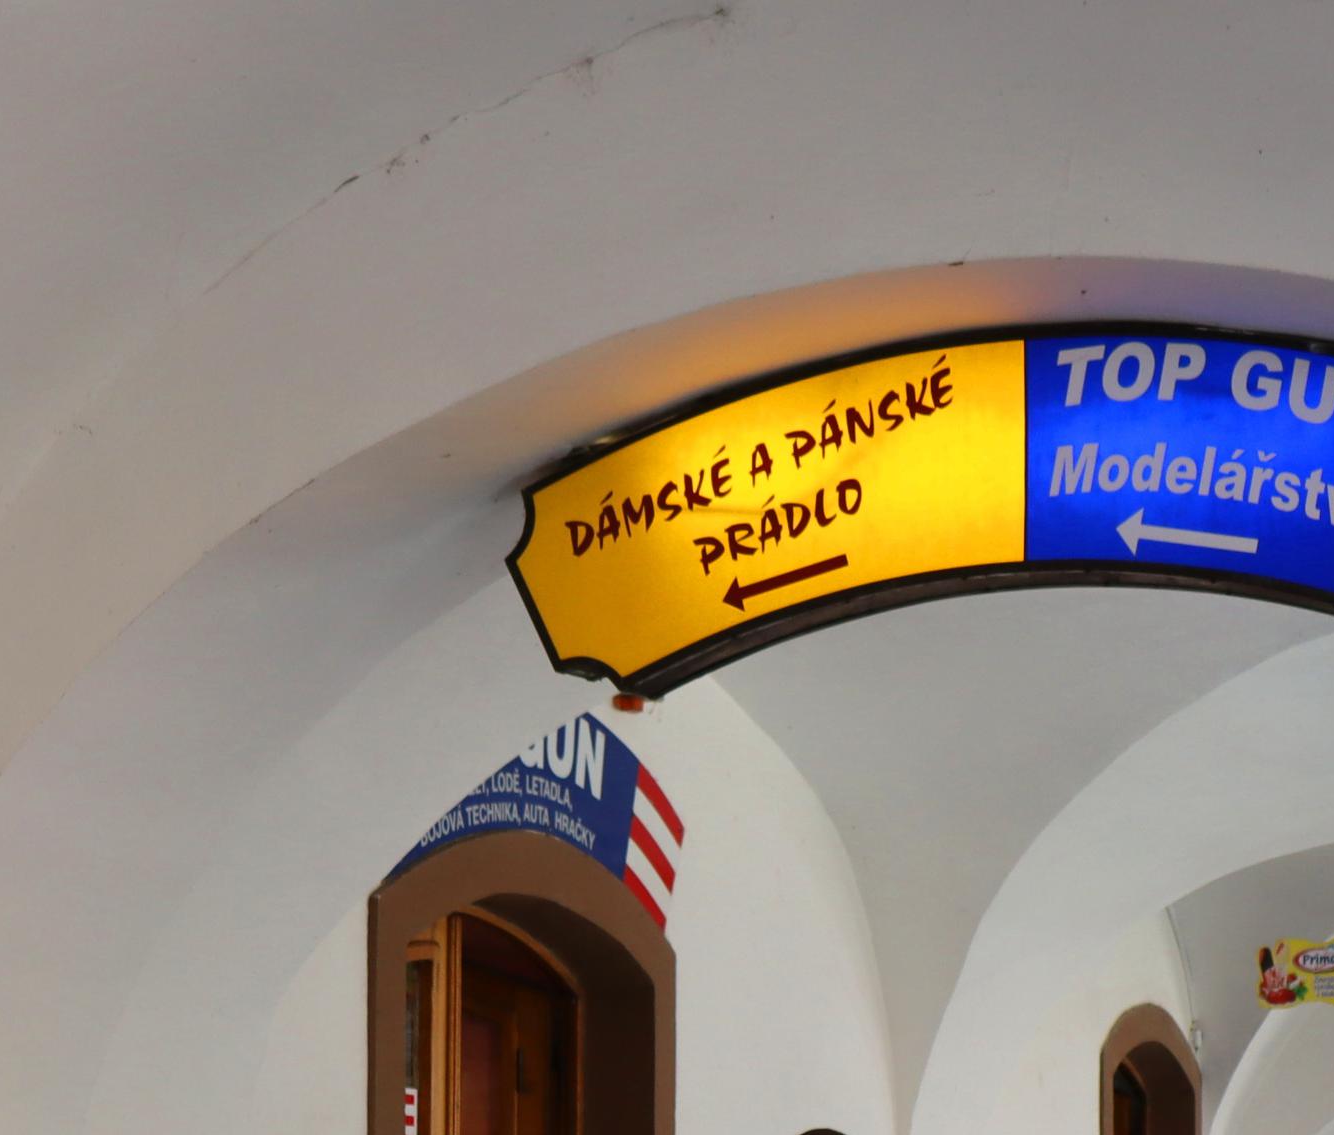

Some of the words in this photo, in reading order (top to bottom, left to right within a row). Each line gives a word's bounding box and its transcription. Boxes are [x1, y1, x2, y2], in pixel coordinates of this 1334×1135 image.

[1056, 341, 1206, 408] TOP
[565, 444, 733, 557] DÁMSKÉ
[750, 443, 774, 488] A
[784, 354, 954, 468] PÁNSKÉ
[693, 478, 863, 576] PRÁDLO
[525, 775, 573, 810] LETADLA,
[466, 802, 521, 827] TECHNIKA,
[554, 810, 596, 851] HRAČKY
